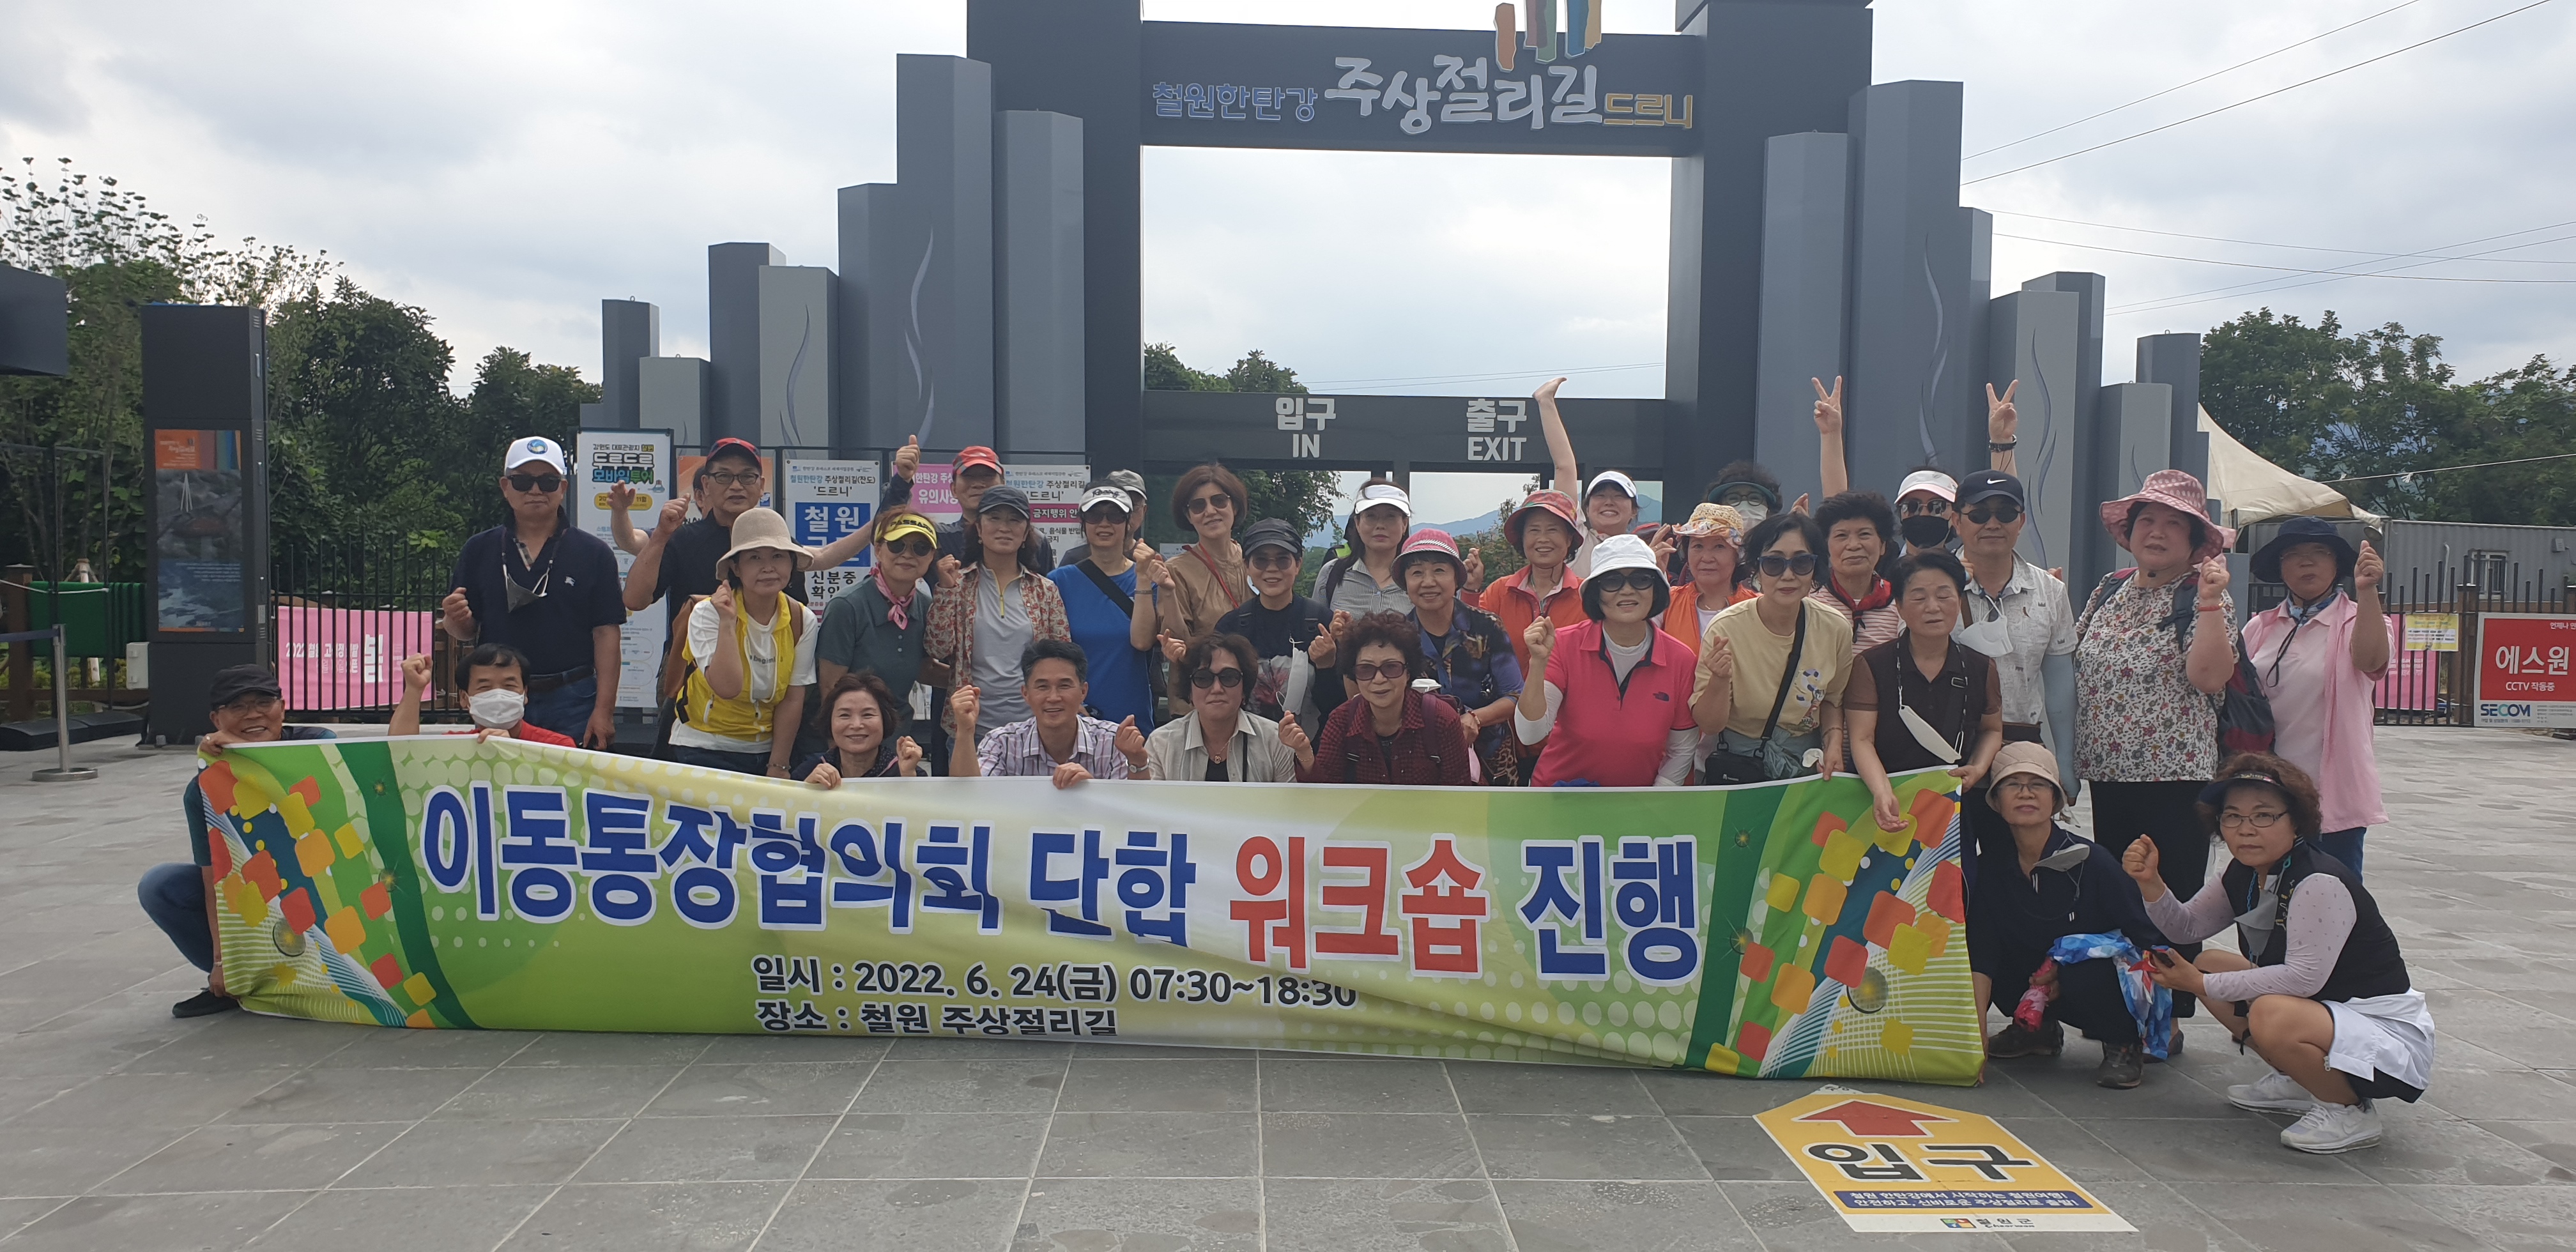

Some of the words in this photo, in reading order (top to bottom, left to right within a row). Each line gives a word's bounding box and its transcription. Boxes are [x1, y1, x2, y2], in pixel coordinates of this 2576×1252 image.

[1152, 82, 1318, 123] 철원한탄강
[1324, 54, 1603, 134] 주상절리길
[1603, 93, 1694, 130] 드르니
[1275, 397, 1337, 431] 입구
[1466, 399, 1528, 433] 출구
[1292, 434, 1320, 458] IN
[1468, 437, 1526, 461] EXIT
[592, 452, 654, 470] 두루두루
[592, 468, 654, 484] 모바일투어
[1046, 480, 1085, 489] 주상절리길
[804, 506, 859, 533] 철원
[1032, 508, 1066, 518] 금지행위
[811, 571, 856, 584] 신분증
[2496, 646, 2570, 675] 에스원
[2506, 682, 2530, 691] CCTV
[2531, 682, 2555, 691] 작동중
[2480, 704, 2531, 717] SECOM
[422, 782, 1000, 931] 이동통장협의회
[1029, 830, 1197, 948] 단합
[1229, 834, 1487, 972] 워크숍
[1520, 841, 1698, 980] 진행
[753, 957, 821, 993] 일시
[855, 963, 955, 996] 2022.
[967, 965, 999, 997] 6.
[1011, 964, 1117, 1002] 24(금)
[1130, 968, 1356, 1006] 07:30~18:30
[756, 1001, 828, 1030] 장소
[861, 1004, 930, 1034] 철원
[942, 1005, 1118, 1035] 주상절리길
[1805, 1143, 2036, 1180] 입구
